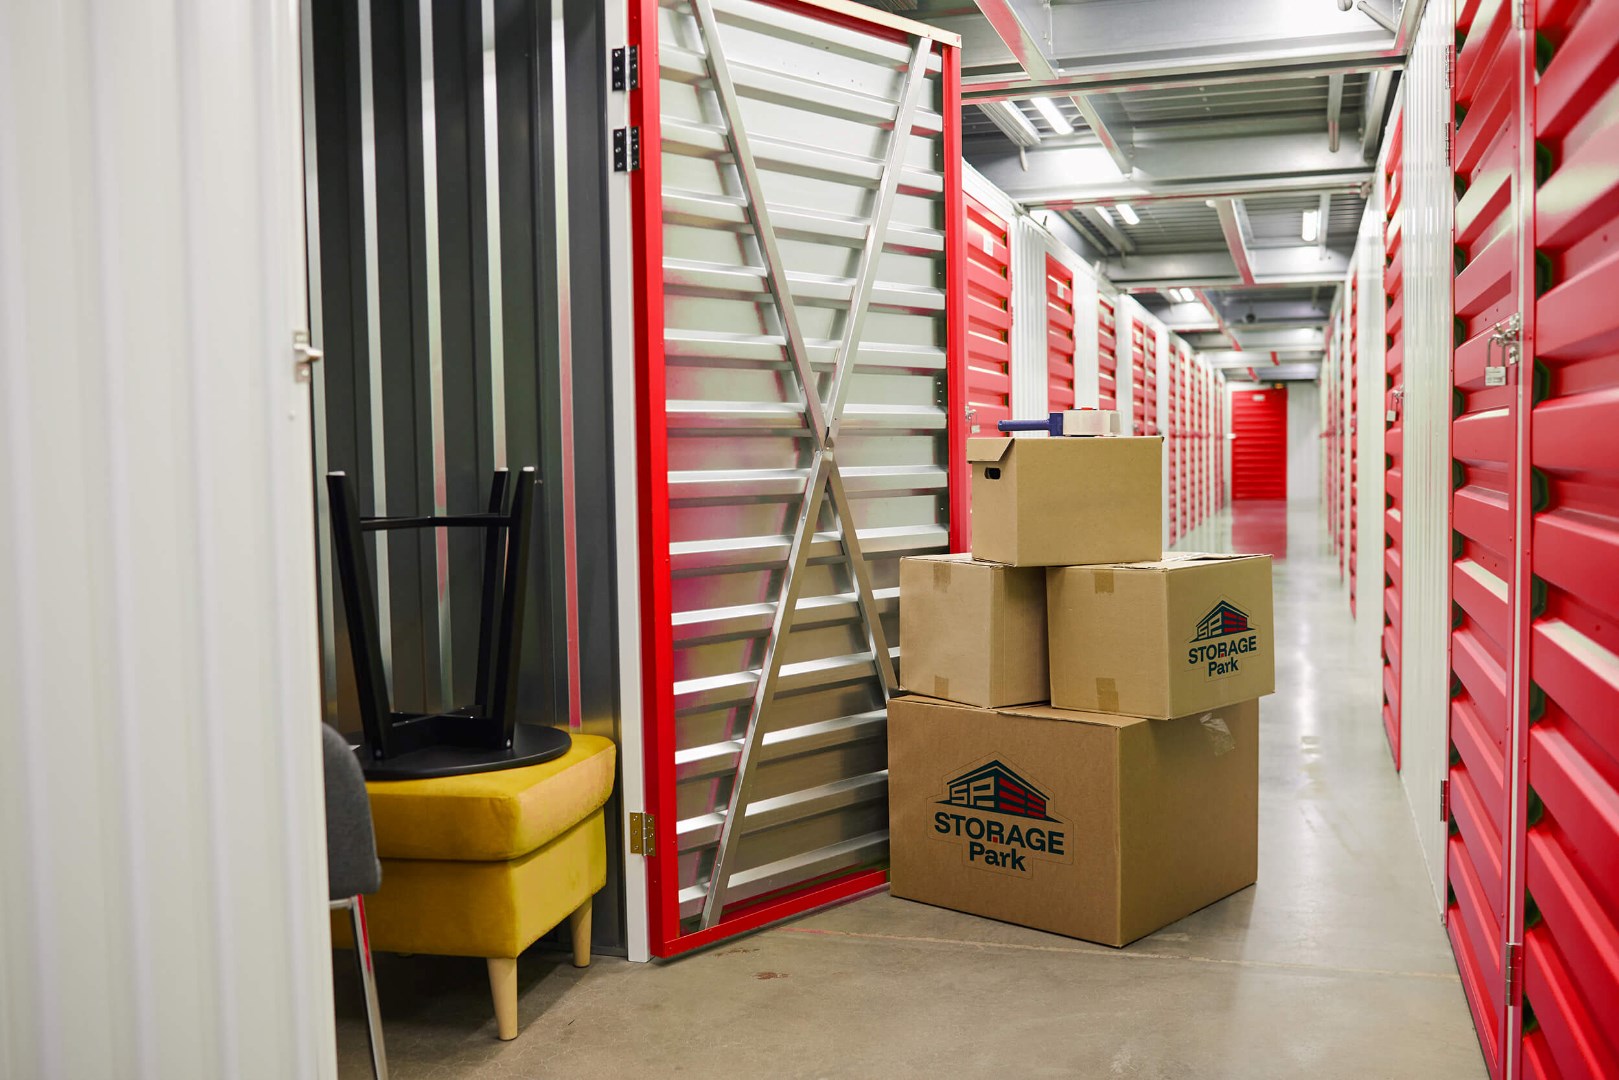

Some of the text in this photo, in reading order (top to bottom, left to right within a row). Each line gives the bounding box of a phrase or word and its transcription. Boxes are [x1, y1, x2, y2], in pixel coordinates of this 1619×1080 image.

[1188, 636, 1257, 664] STORAGE
[1208, 657, 1239, 677] Park
[934, 812, 1065, 855] STORAGE
[969, 841, 1026, 871] Park
